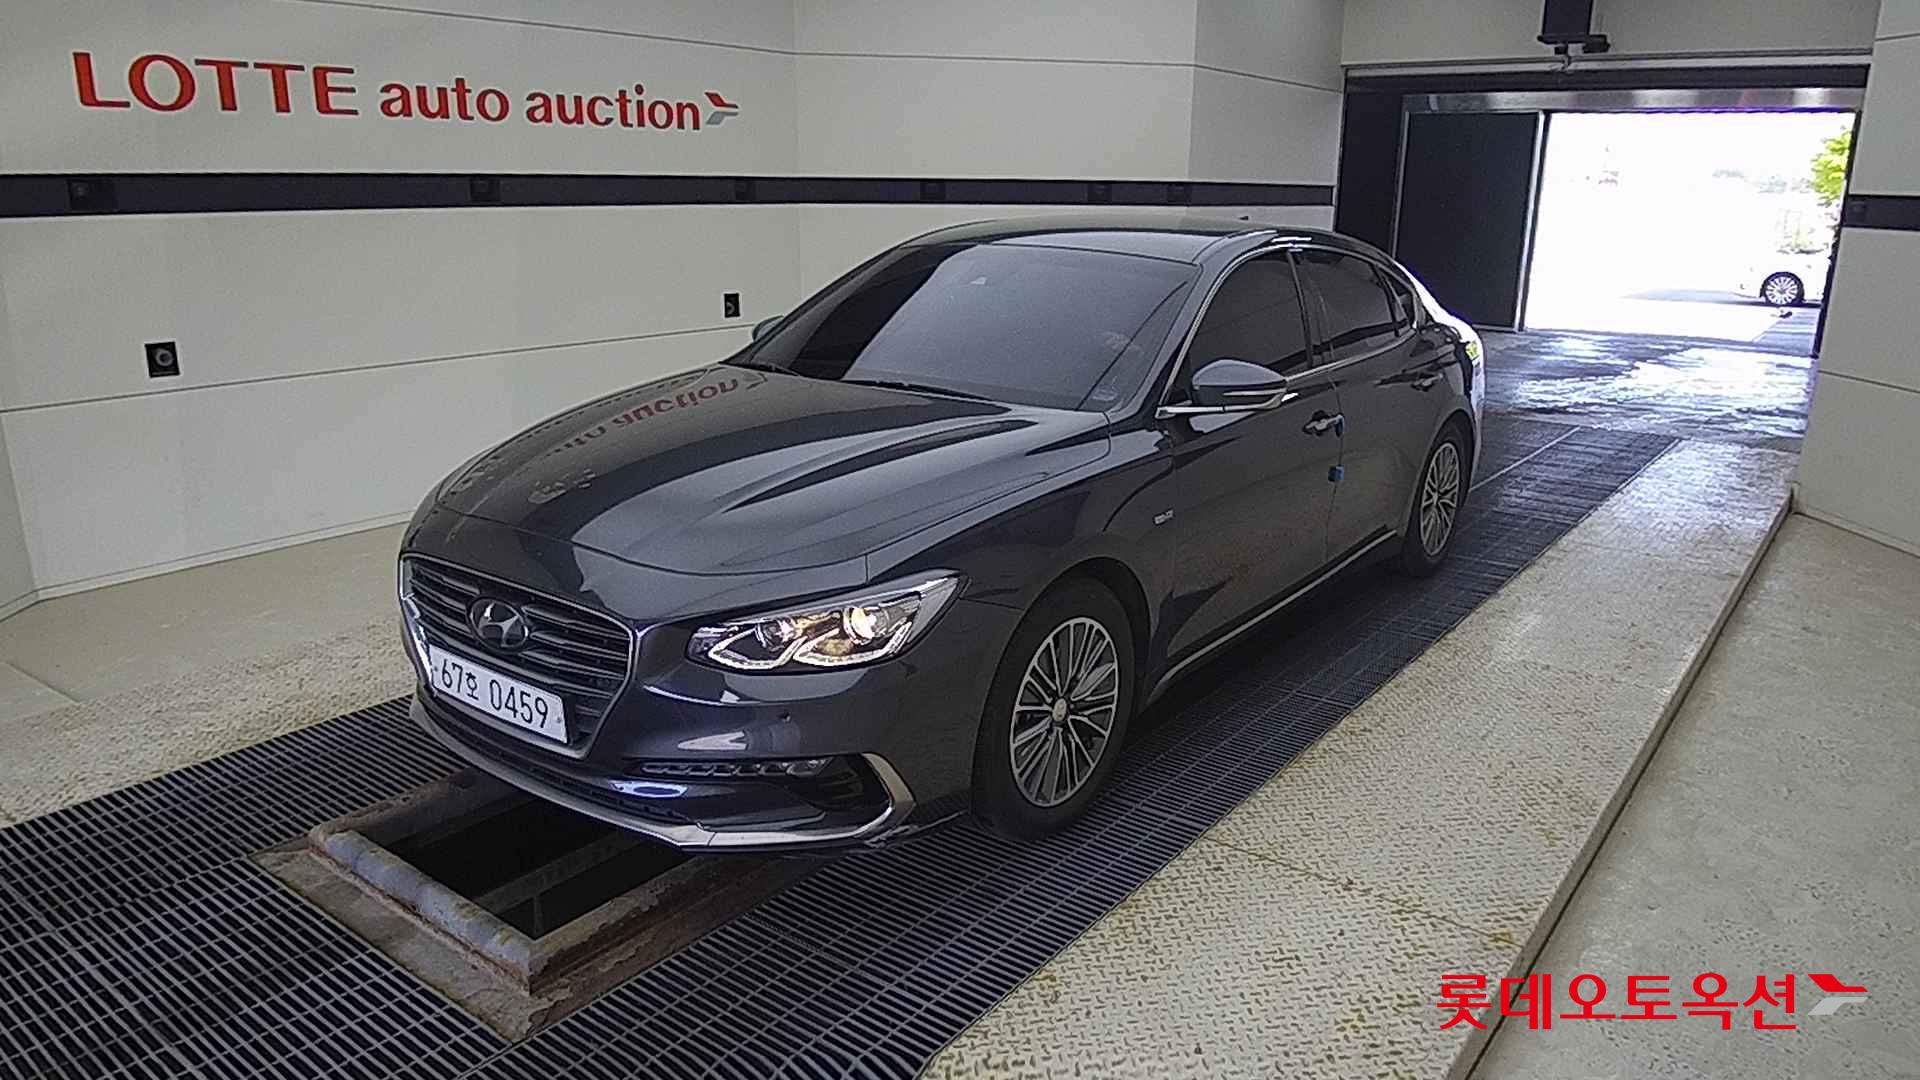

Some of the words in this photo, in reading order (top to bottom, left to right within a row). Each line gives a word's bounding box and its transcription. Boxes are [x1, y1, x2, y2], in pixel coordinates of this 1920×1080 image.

[73, 51, 359, 116] LOTTE
[380, 77, 510, 123] auto
[526, 83, 701, 131] auction
[441, 658, 480, 701] 67호
[489, 678, 549, 729] 0459
